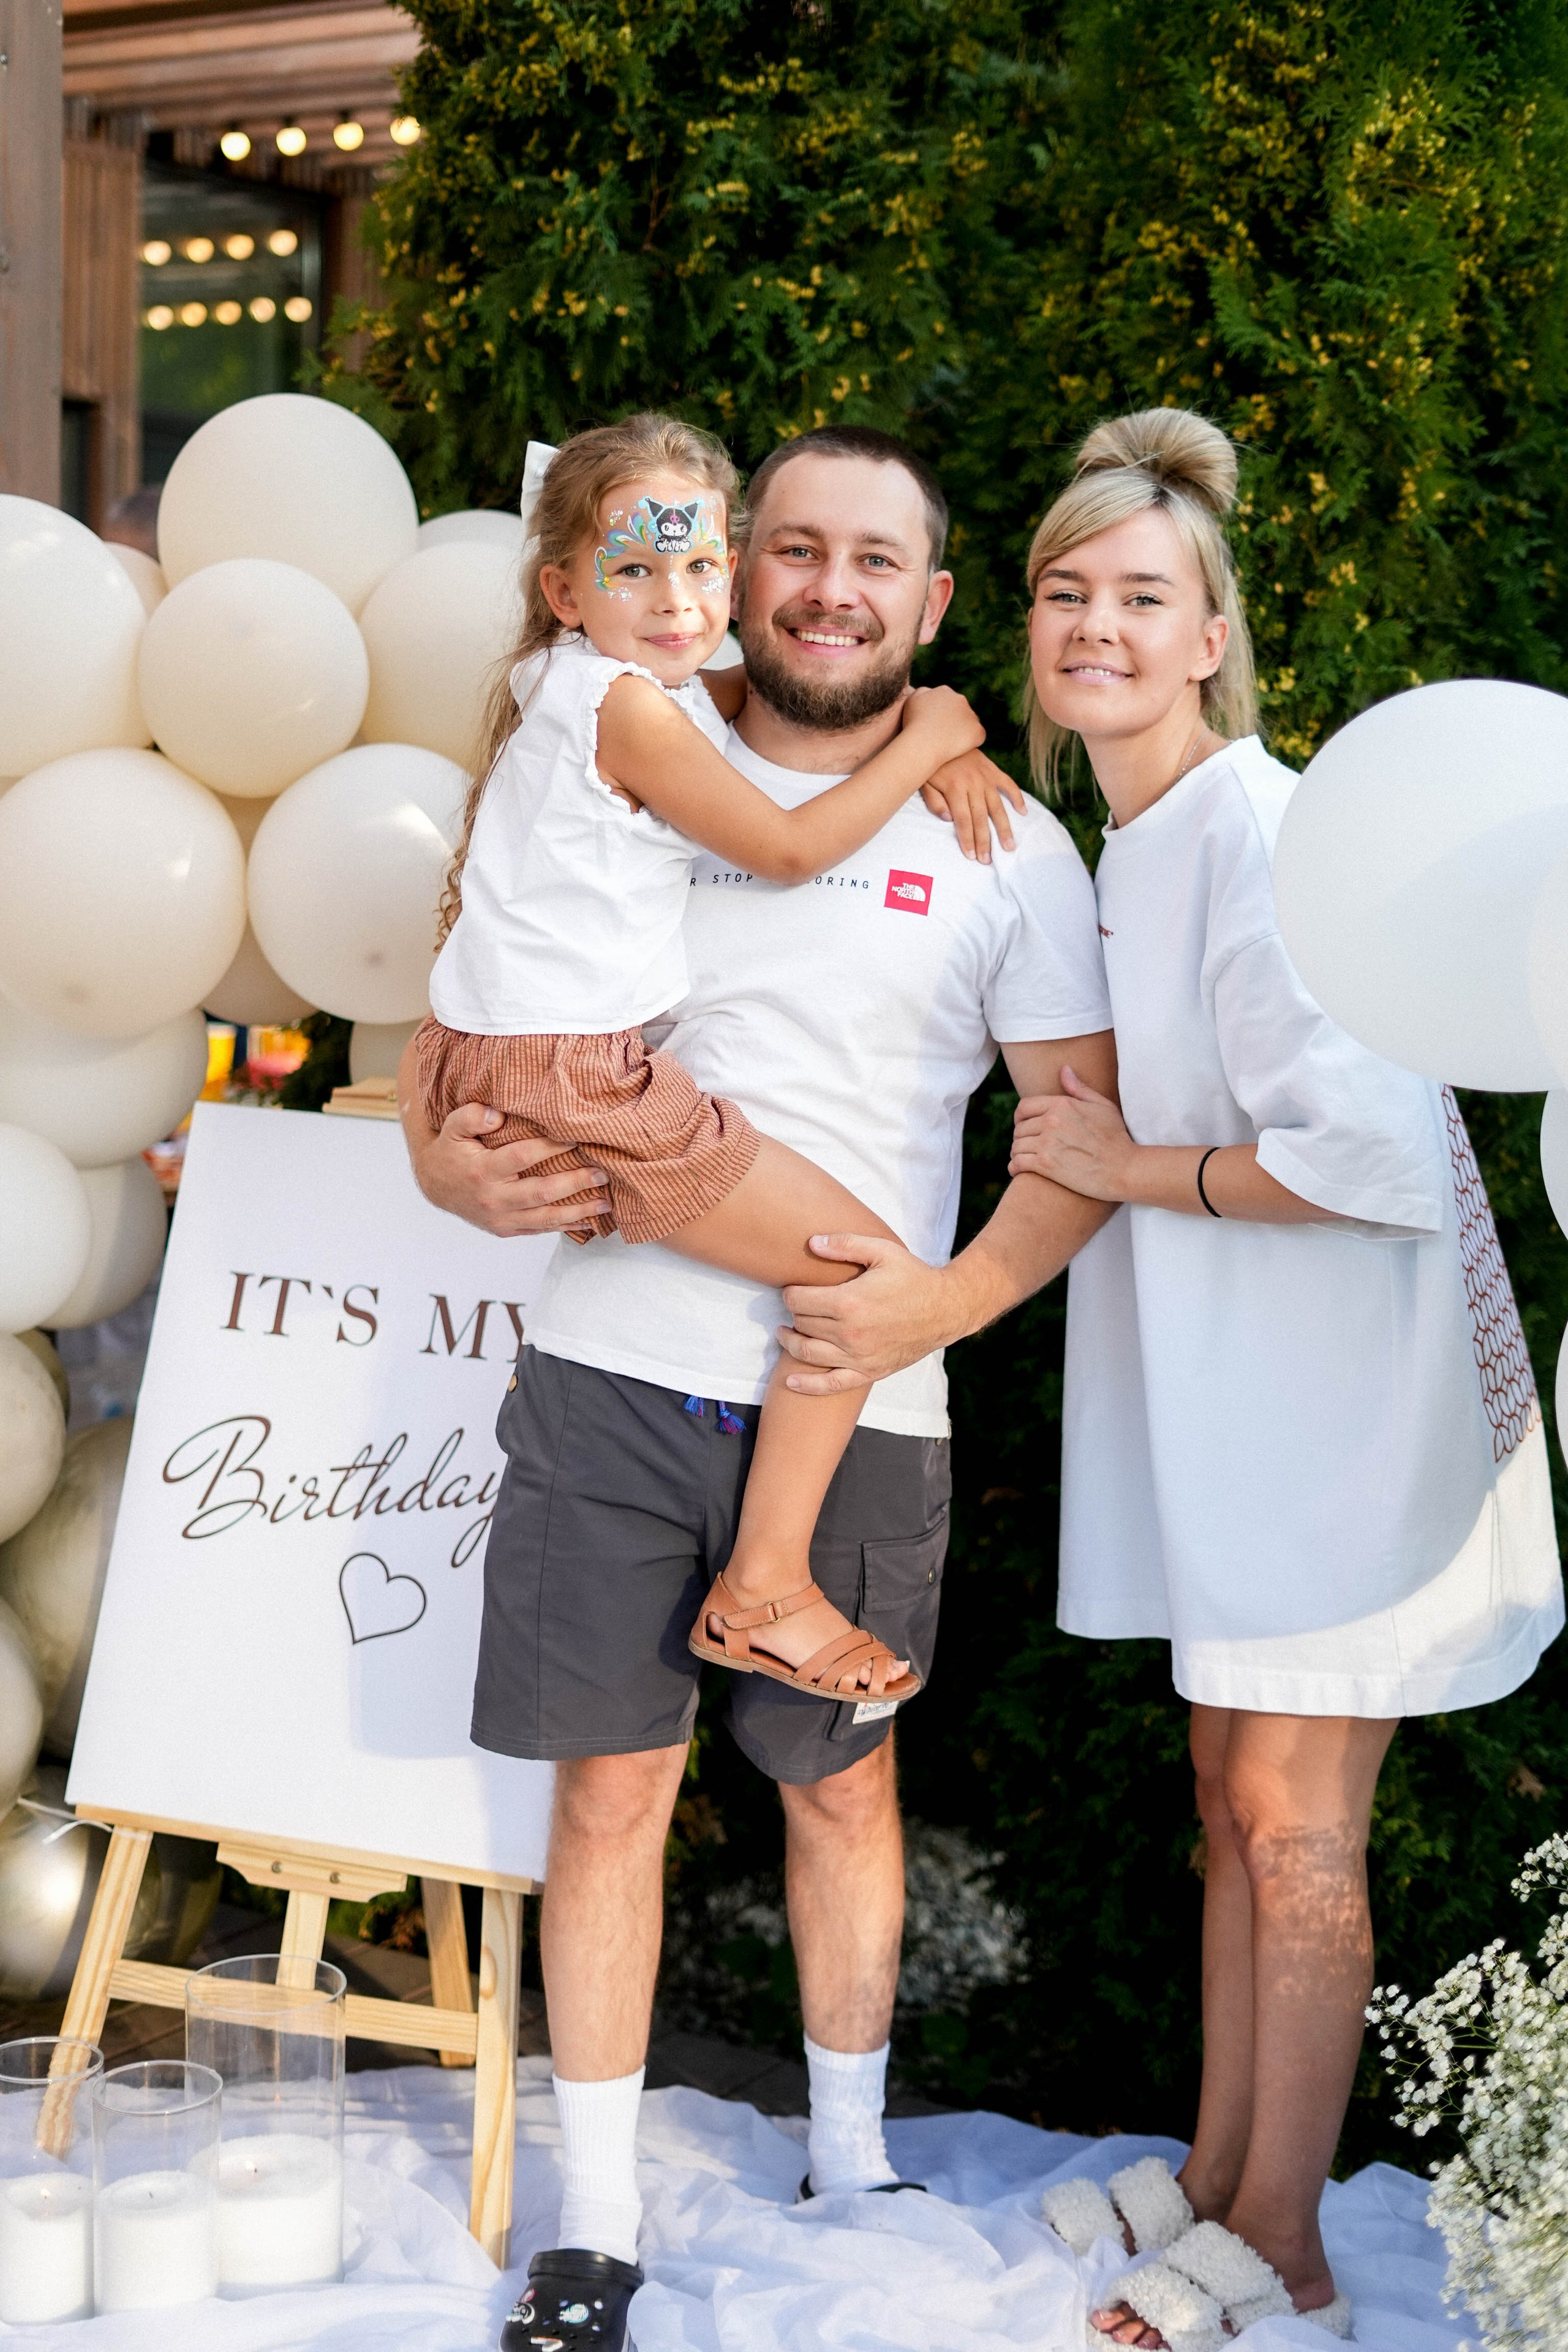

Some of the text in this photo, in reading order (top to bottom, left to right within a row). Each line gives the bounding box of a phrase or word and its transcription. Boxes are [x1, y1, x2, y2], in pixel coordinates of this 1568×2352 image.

[712, 873, 753, 883] STOP
[807, 876, 869, 889] ORING
[892, 886, 914, 895] NORTH
[897, 891, 914, 900] FACE
[419, 1293, 526, 1363] MY
[162, 1415, 499, 1568] Birthday
